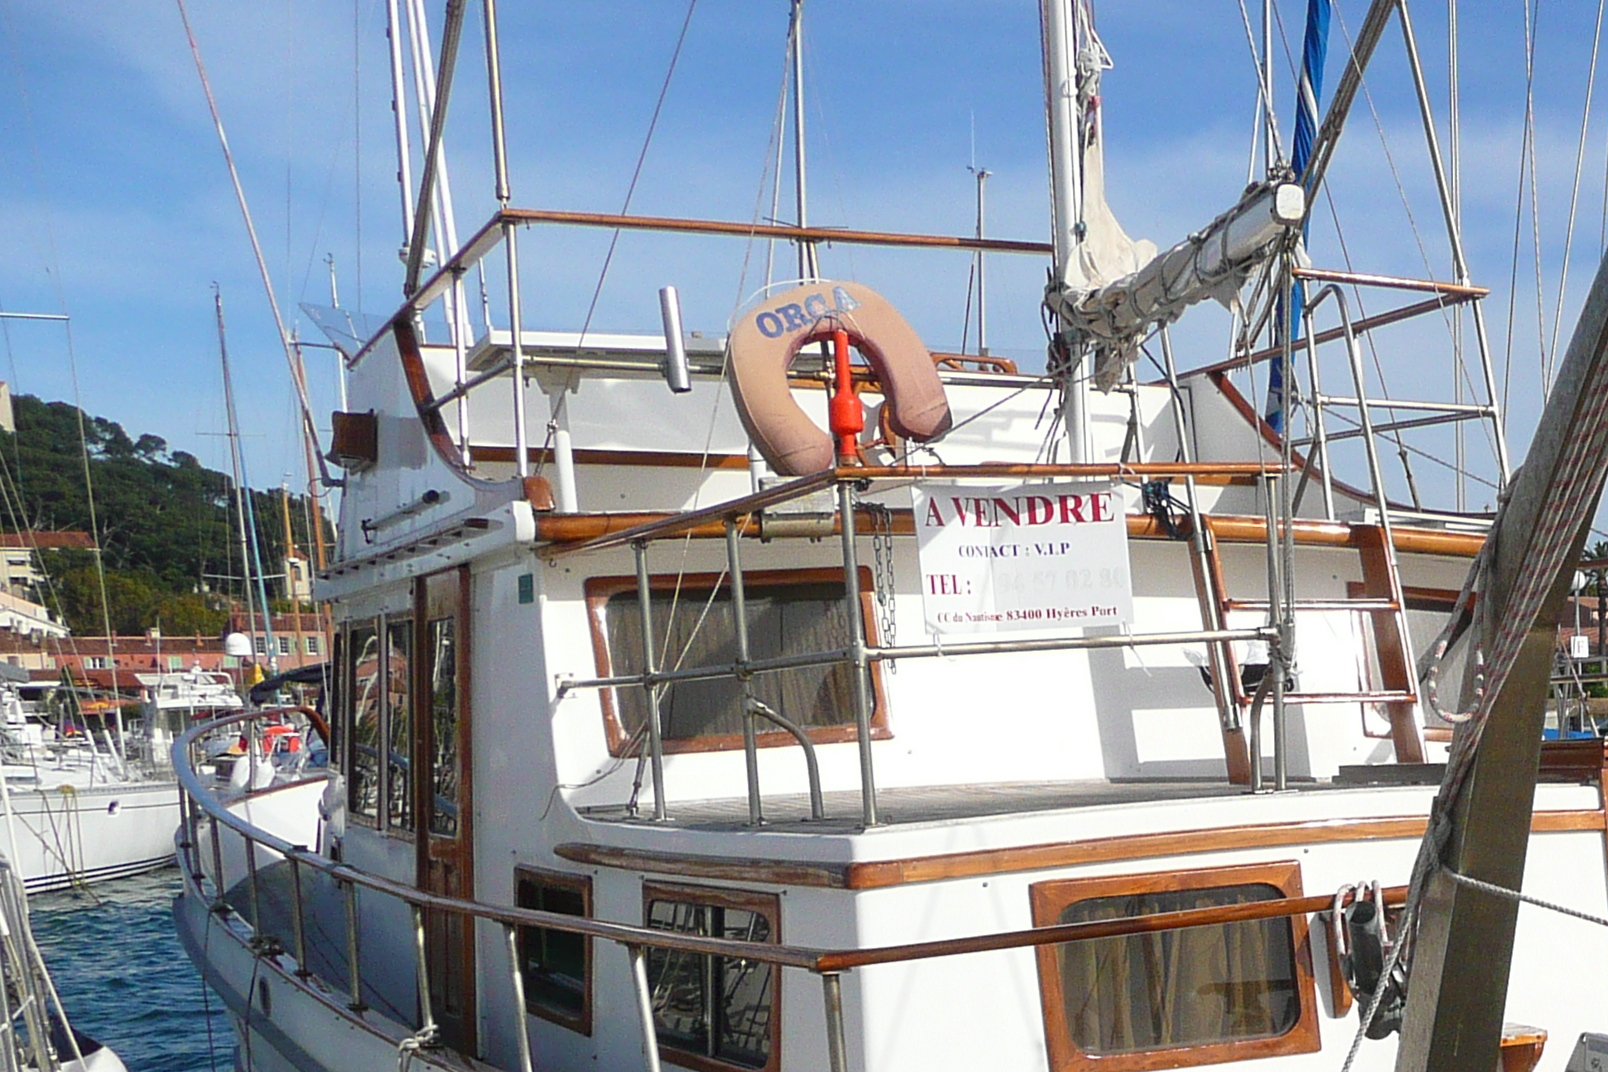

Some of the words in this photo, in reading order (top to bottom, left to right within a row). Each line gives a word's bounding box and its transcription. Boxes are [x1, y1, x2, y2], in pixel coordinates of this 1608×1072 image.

[755, 286, 862, 339] ORCA
[925, 496, 945, 527] A
[951, 492, 1115, 527] VENDRE
[958, 544, 1021, 558] CONTACT
[1034, 542, 1071, 556] V.I.P
[1006, 609, 1043, 620] 83400
[1046, 606, 1088, 621] Hyères
[1091, 605, 1118, 616] Port
